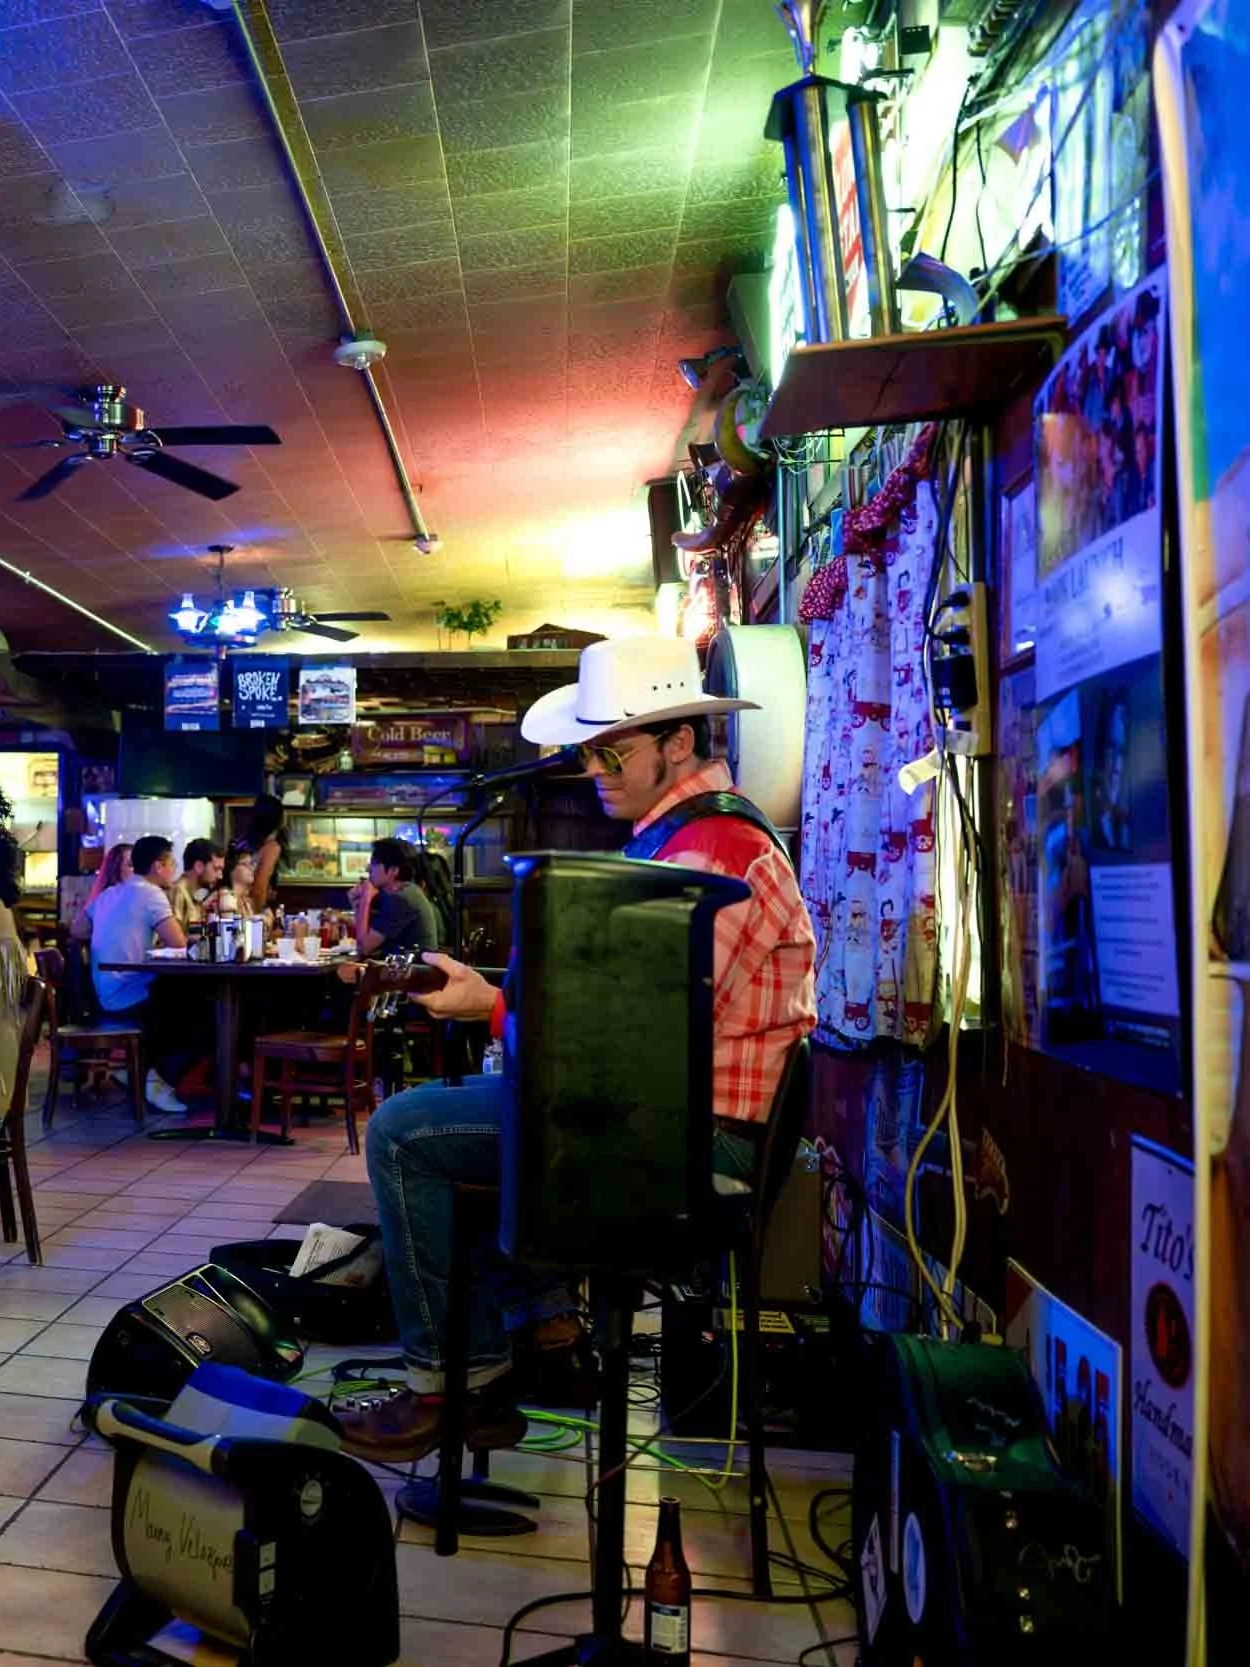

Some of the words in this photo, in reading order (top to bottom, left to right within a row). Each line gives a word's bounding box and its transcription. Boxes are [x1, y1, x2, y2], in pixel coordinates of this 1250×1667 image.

[237, 671, 281, 690] BROKEN
[367, 725, 405, 741] Cold
[410, 725, 452, 741] Beer
